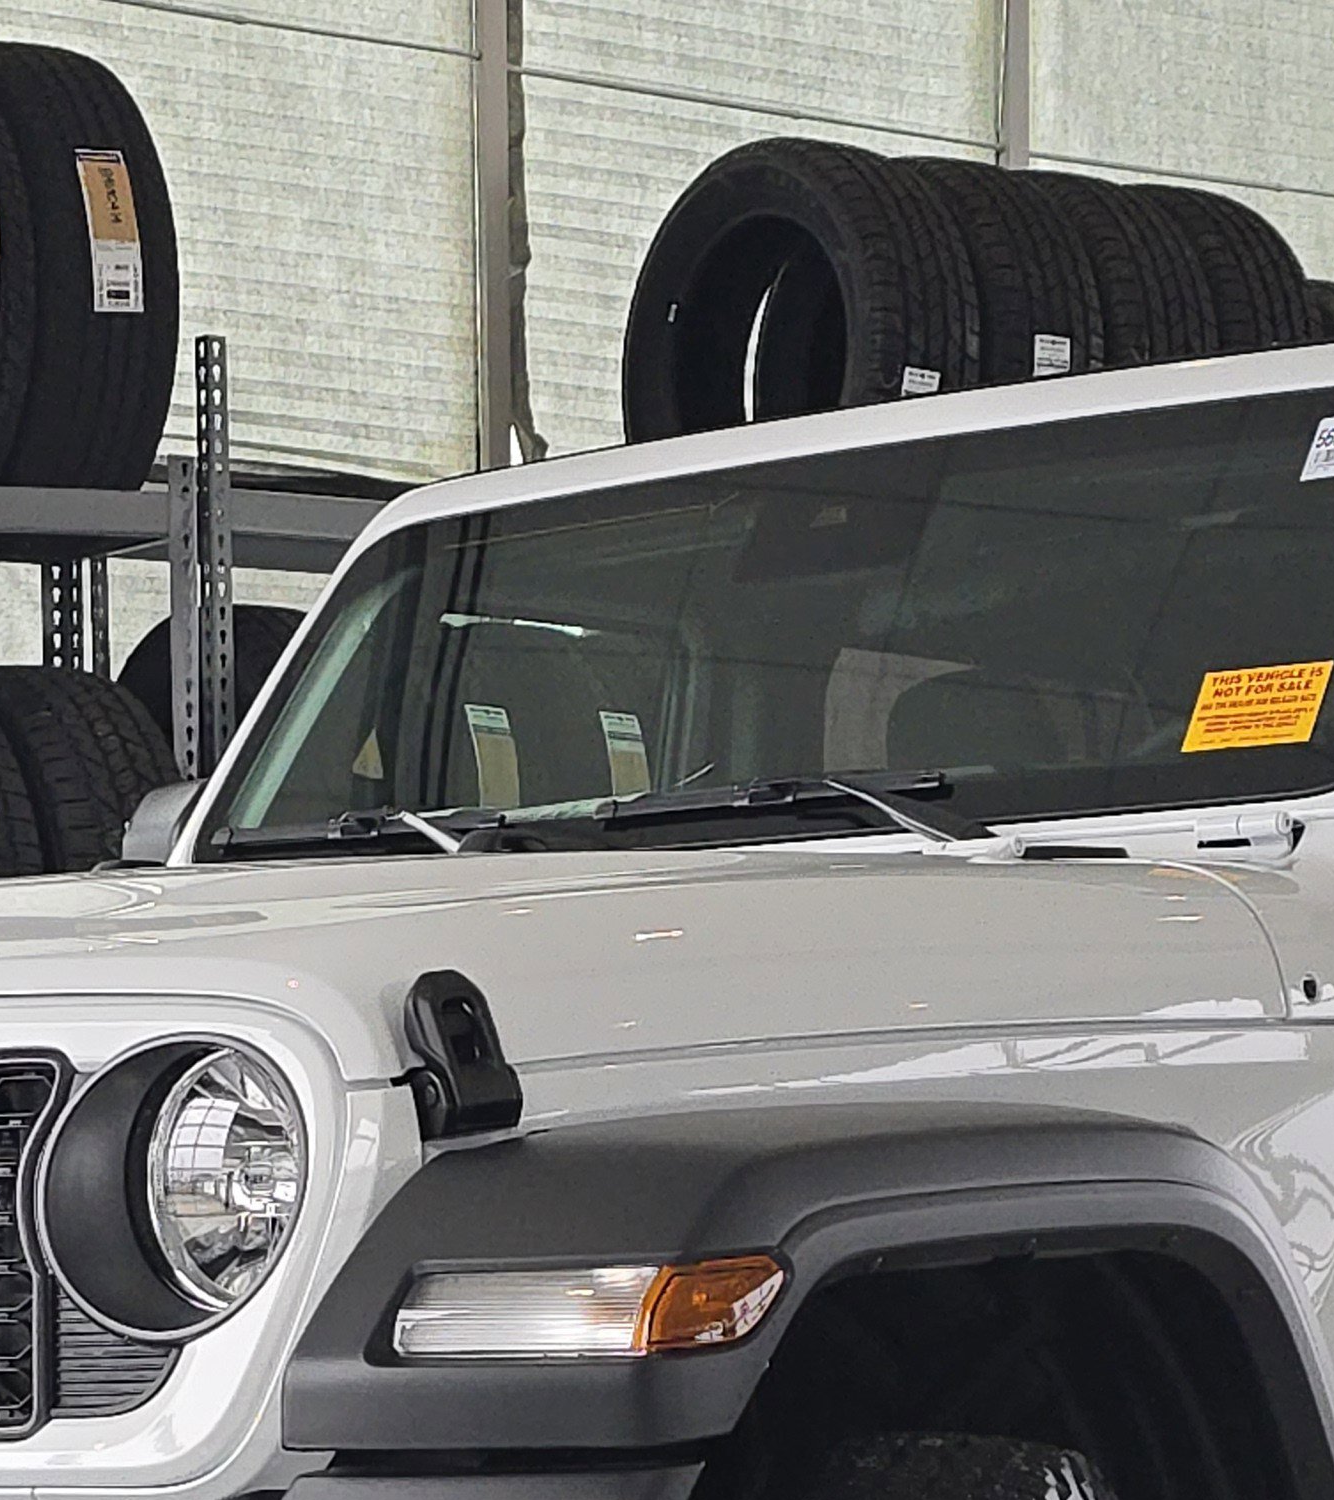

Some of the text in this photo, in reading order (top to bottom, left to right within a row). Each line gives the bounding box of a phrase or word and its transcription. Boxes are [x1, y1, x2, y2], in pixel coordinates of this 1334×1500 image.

[1212, 666, 1324, 688] THIS VEHICLE IS
[1212, 679, 1313, 699] NOT FOR SALE
